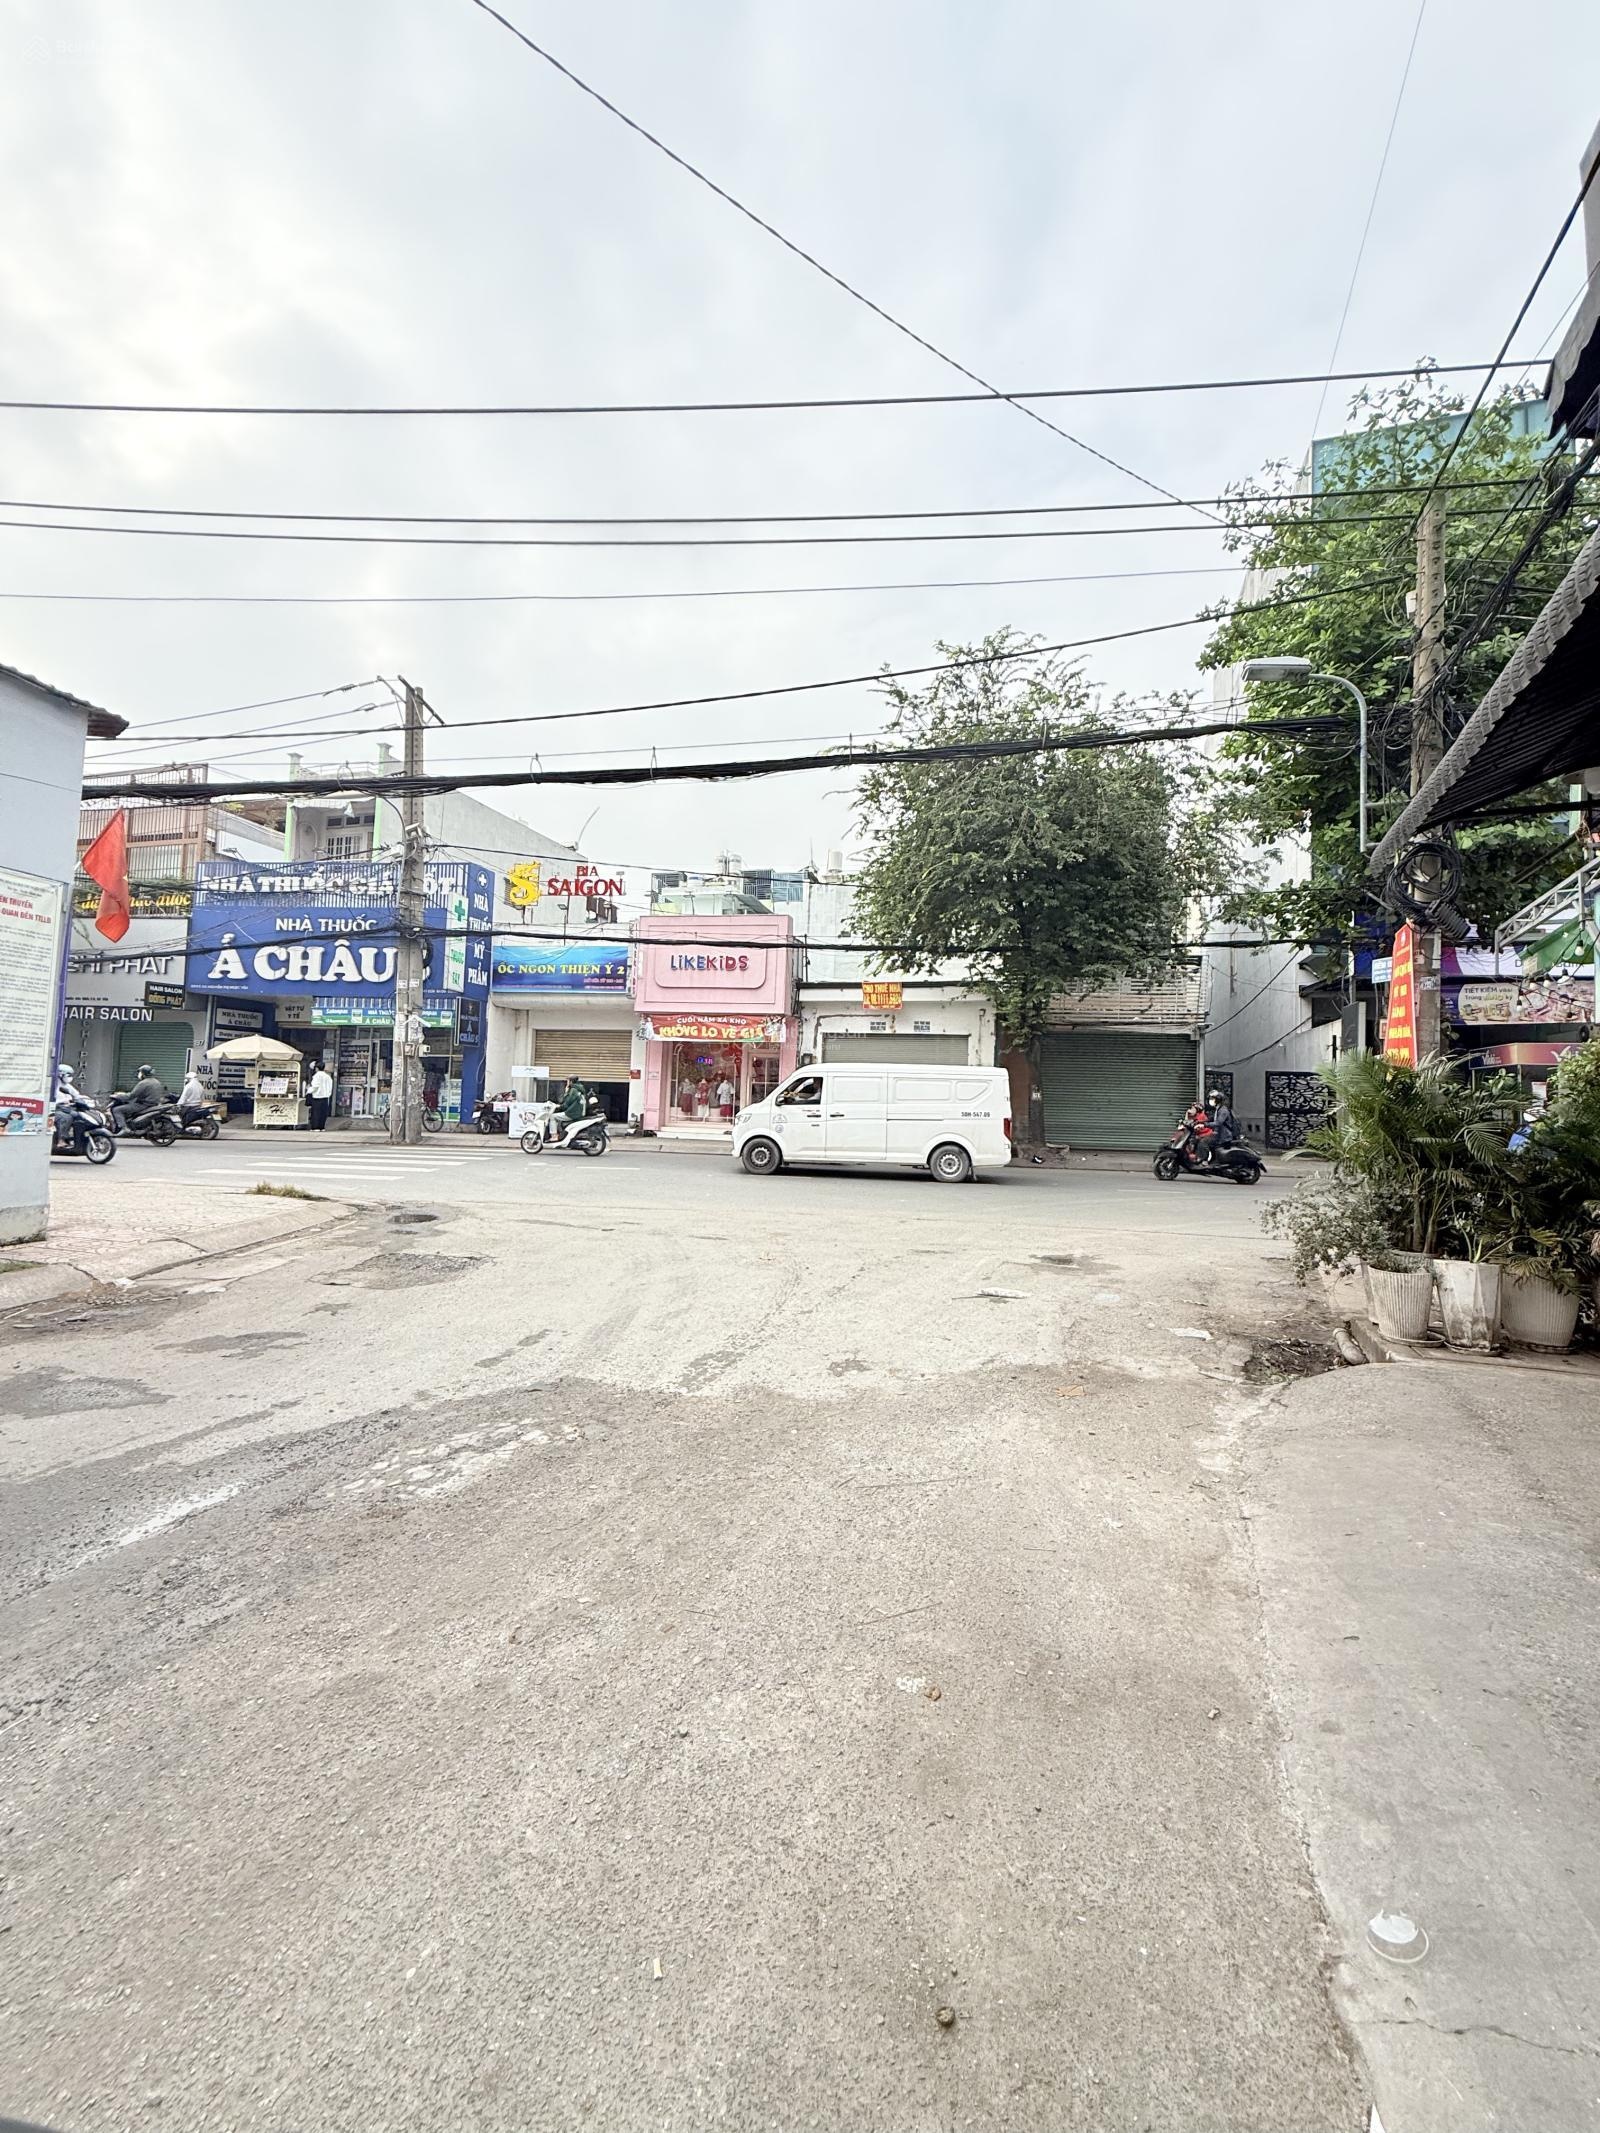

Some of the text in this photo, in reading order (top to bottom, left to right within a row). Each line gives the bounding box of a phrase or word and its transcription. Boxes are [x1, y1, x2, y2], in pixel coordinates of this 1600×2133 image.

[576, 866, 599, 876] BIA
[547, 878, 623, 896] SAIGON
[474, 893, 489, 912] NHÀ
[276, 914, 377, 932] NHÀ THUỐC
[254, 939, 398, 983] CHÂU
[519, 965, 556, 974] NGON
[561, 963, 600, 976] THIỆN
[617, 966, 625, 974] 2
[100, 1008, 152, 1021] SALON
[730, 1017, 747, 1025] KHO
[659, 1024, 699, 1037] KHÔNG
[702, 1026, 719, 1038] LO
[197, 1062, 213, 1075] NHÀ
